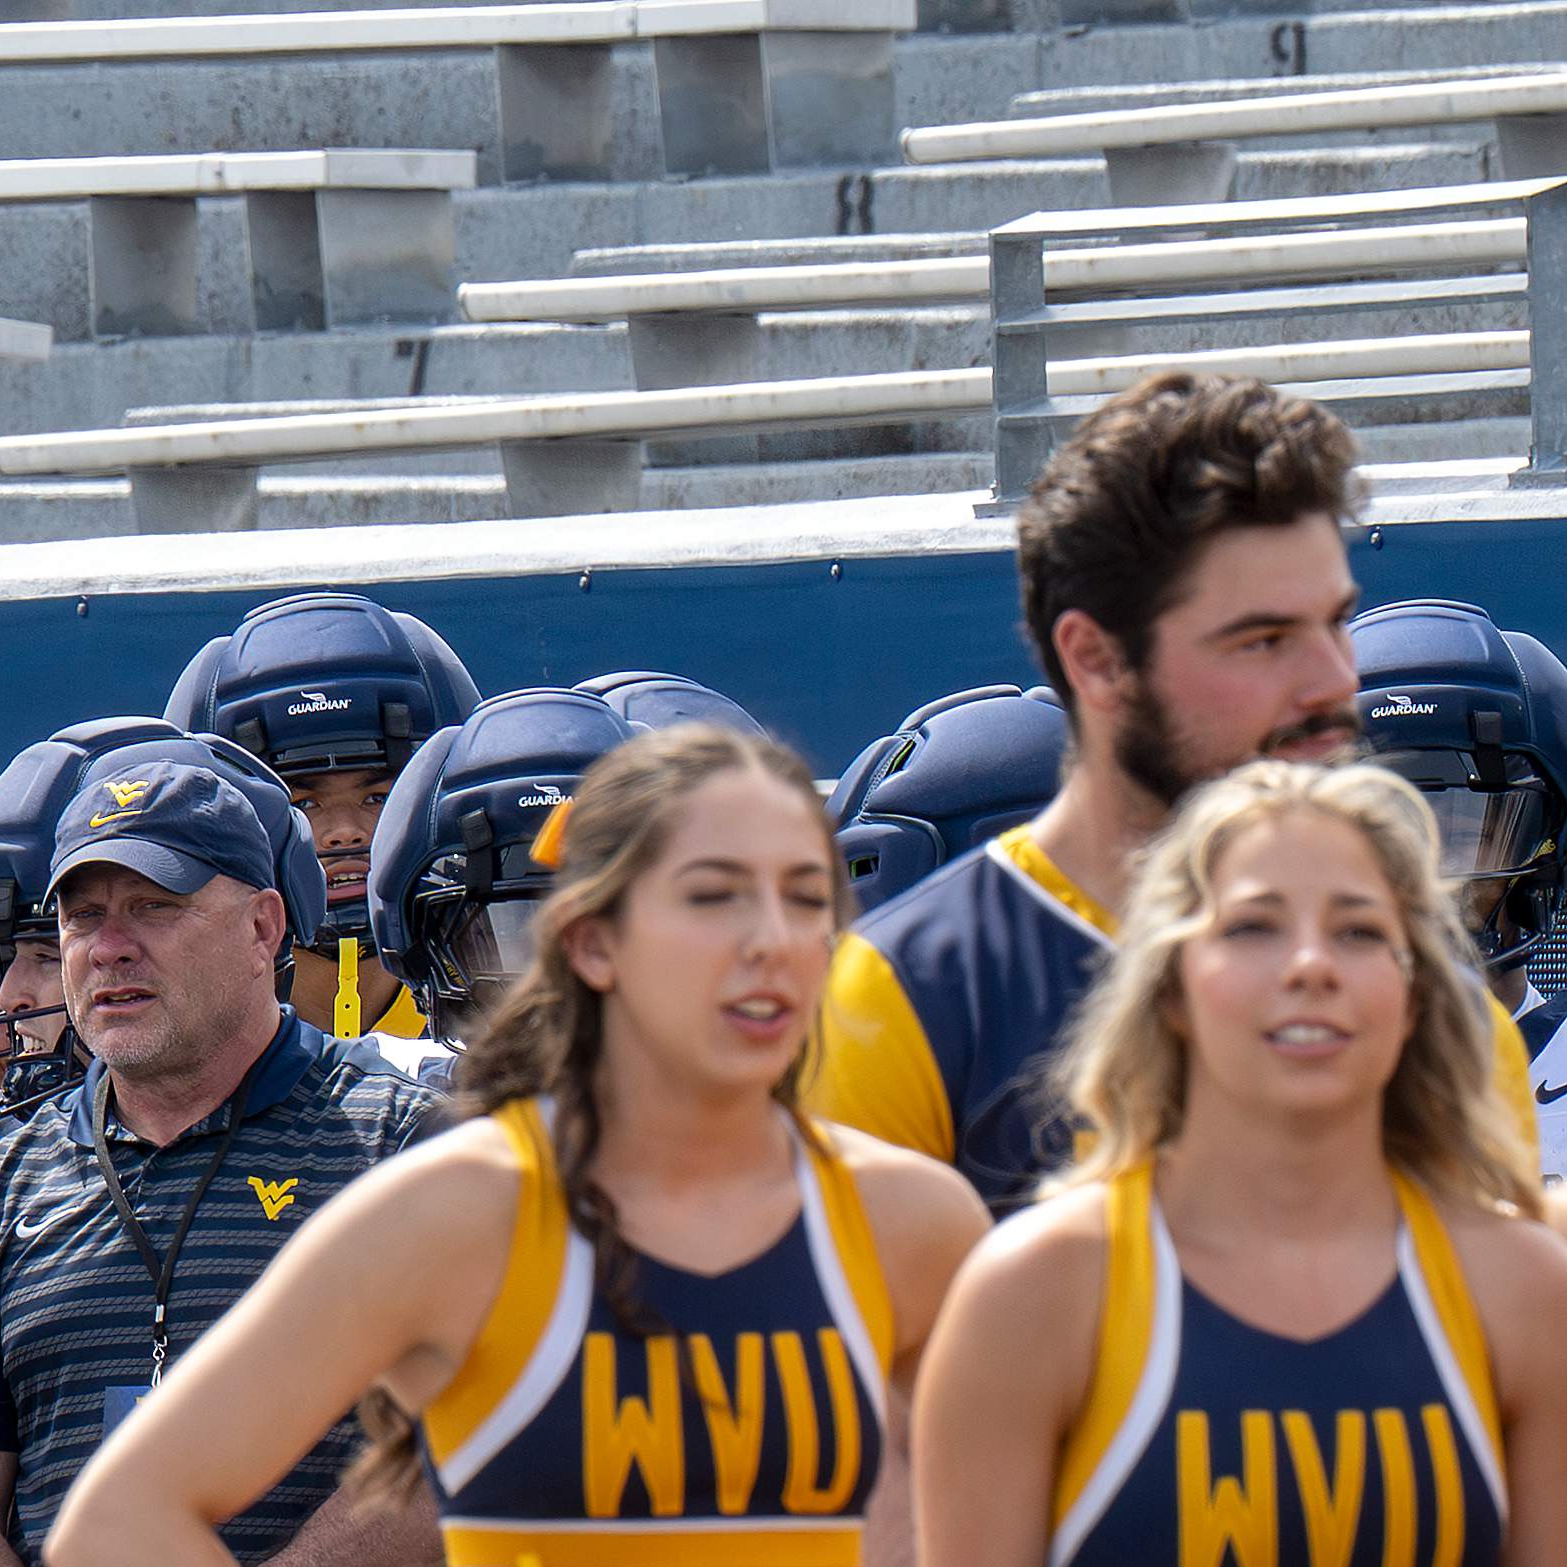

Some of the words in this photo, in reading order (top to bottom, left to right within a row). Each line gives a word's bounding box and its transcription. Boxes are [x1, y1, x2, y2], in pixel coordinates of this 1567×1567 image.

[395, 337, 430, 396] 7
[288, 698, 352, 716] GUARDIAN
[1371, 703, 1438, 719] GUARDIAN
[581, 1328, 861, 1518] WVU
